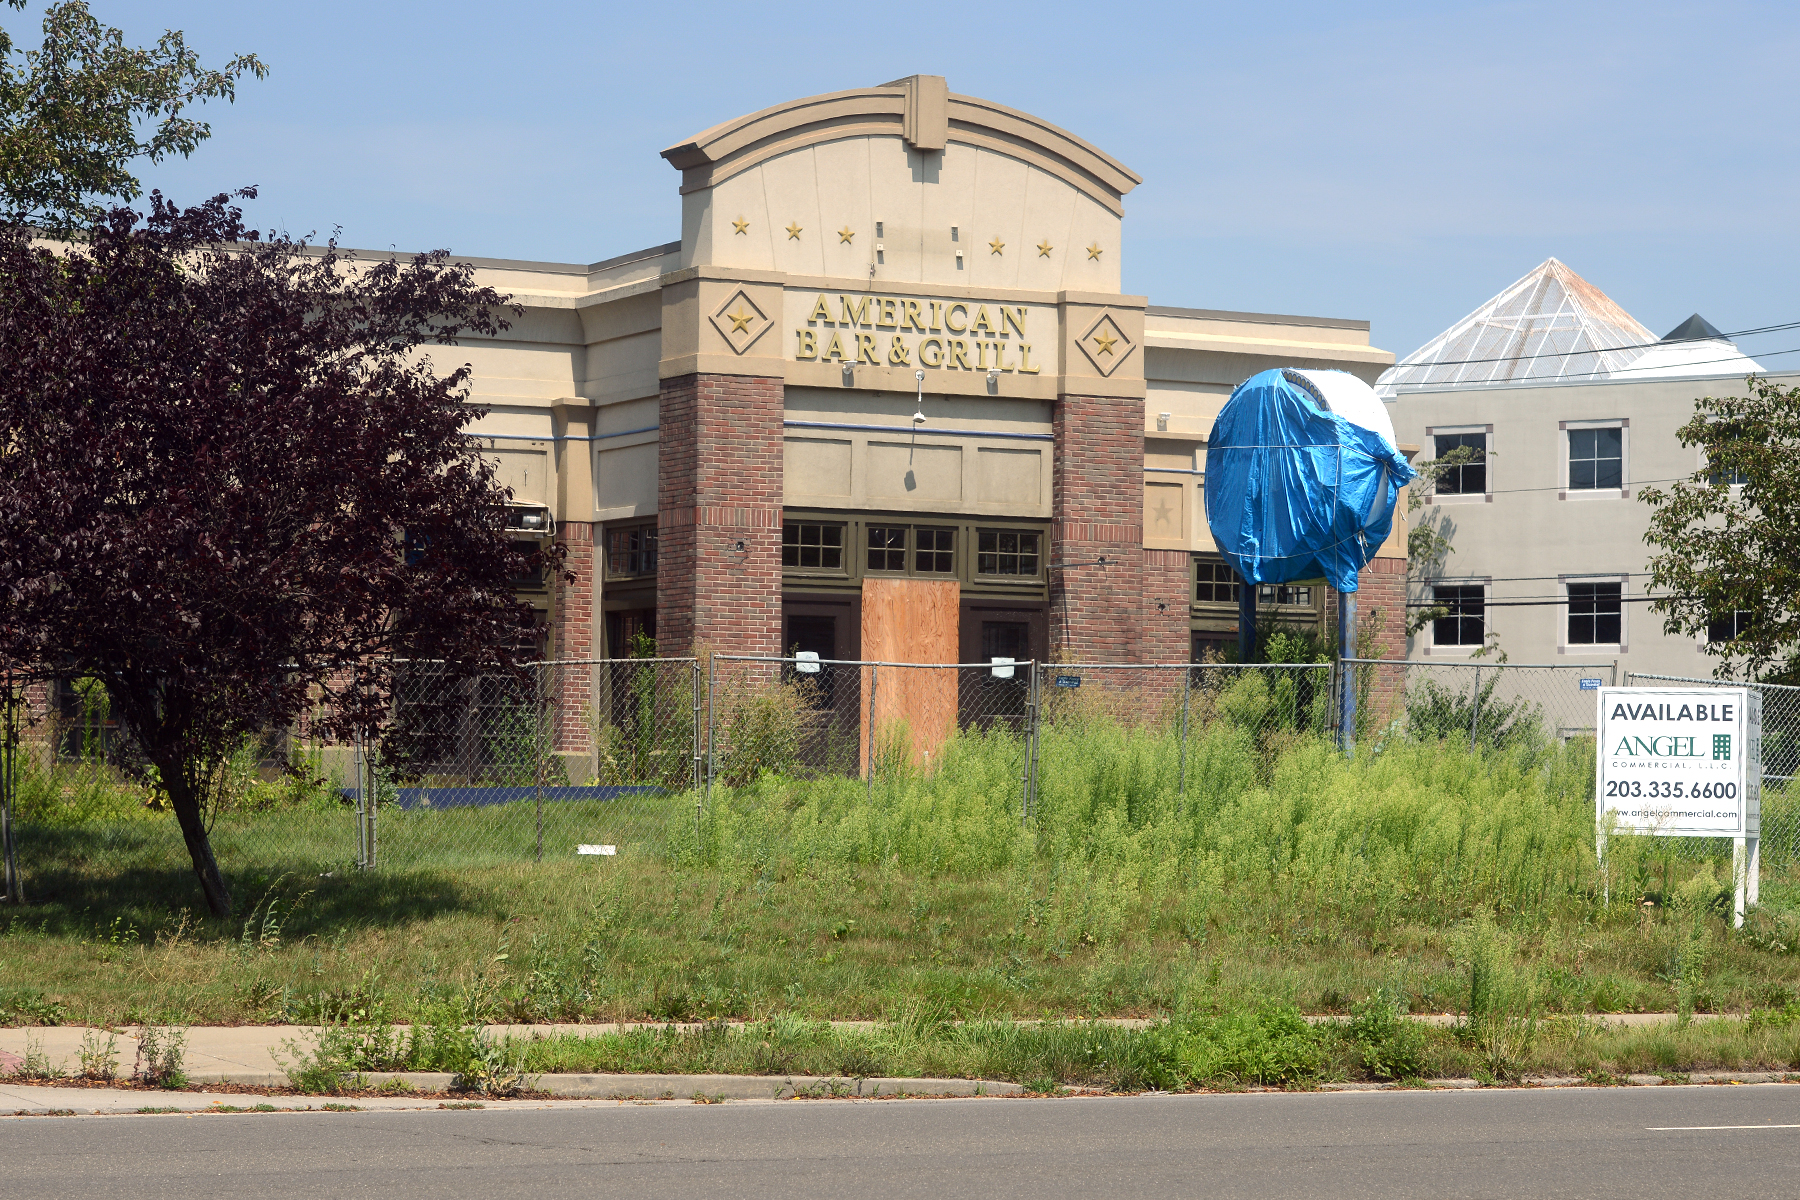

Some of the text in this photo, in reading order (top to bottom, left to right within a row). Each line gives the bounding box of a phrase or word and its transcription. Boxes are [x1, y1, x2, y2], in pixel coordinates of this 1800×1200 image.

[807, 293, 1028, 336] AMERICAN
[1610, 703, 1734, 722] AVAILABLE
[1613, 735, 1706, 757] ANGEL
[1612, 761, 1692, 769] COMMERCIAL,
[1605, 780, 1737, 799] 203.335.6600
[1606, 808, 1738, 819] ww.angelcommercial.com
